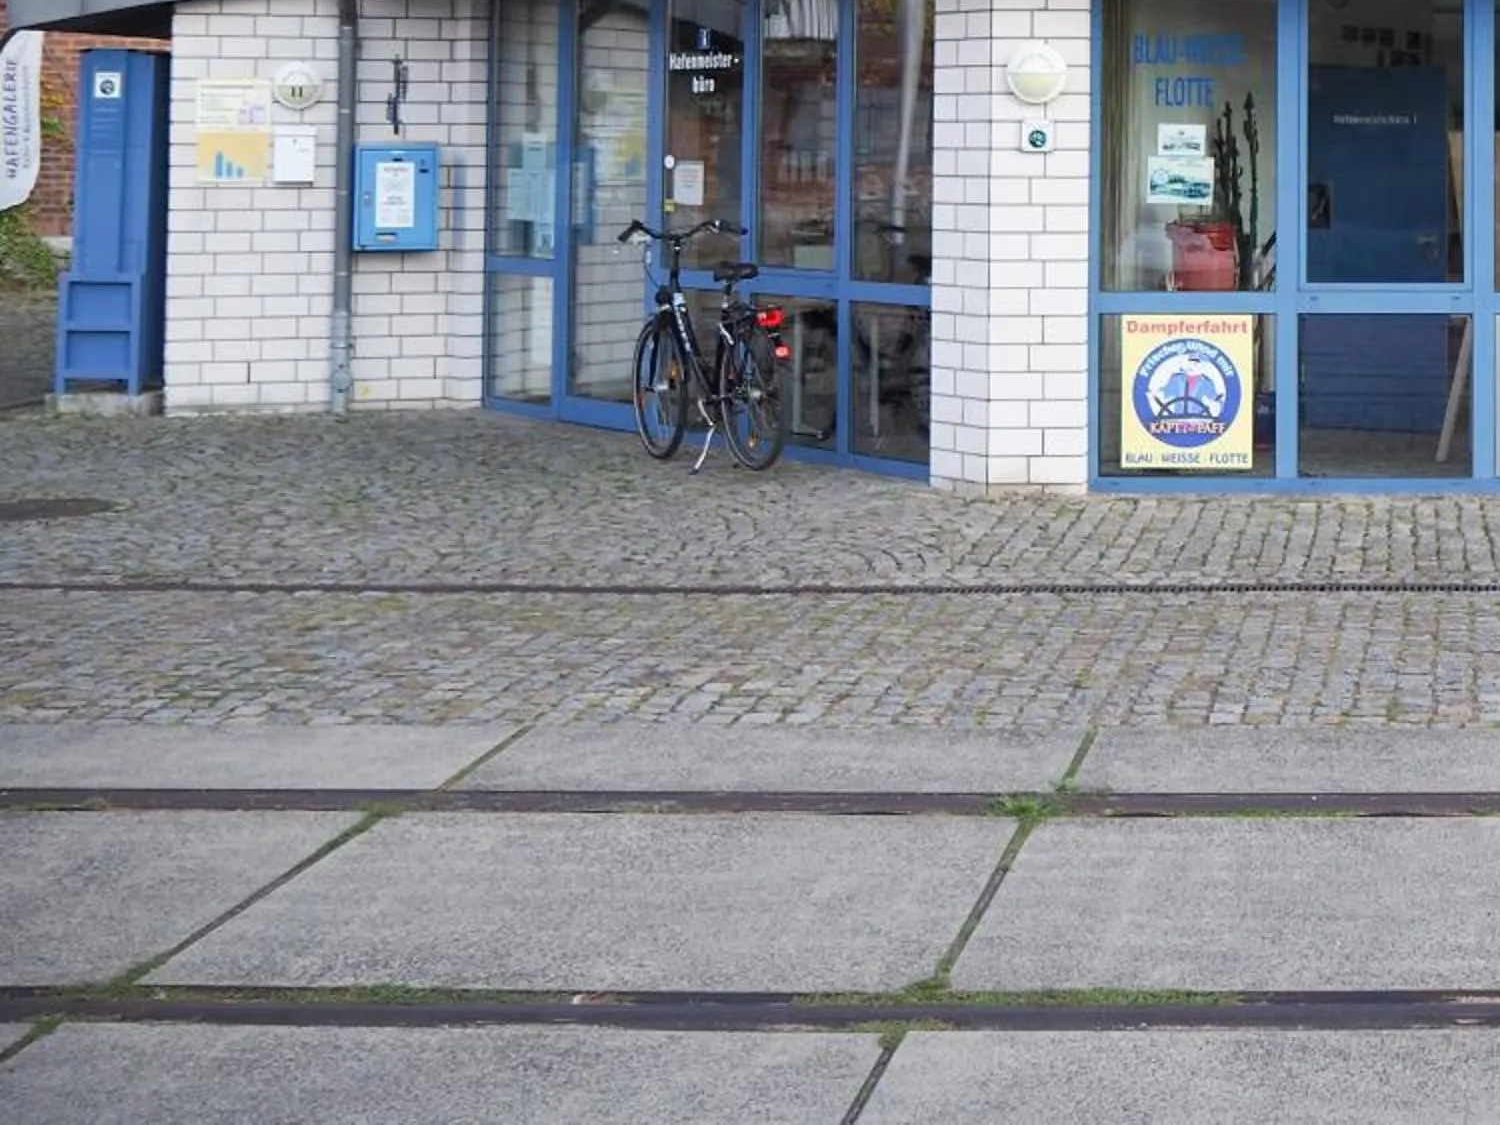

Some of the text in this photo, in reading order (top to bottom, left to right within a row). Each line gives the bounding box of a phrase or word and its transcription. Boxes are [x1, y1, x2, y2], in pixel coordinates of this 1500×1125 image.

[1155, 76, 1216, 108] FLOTTE
[1126, 320, 1249, 336] Dampferfahrt
[1209, 452, 1249, 464] FLOTTE
